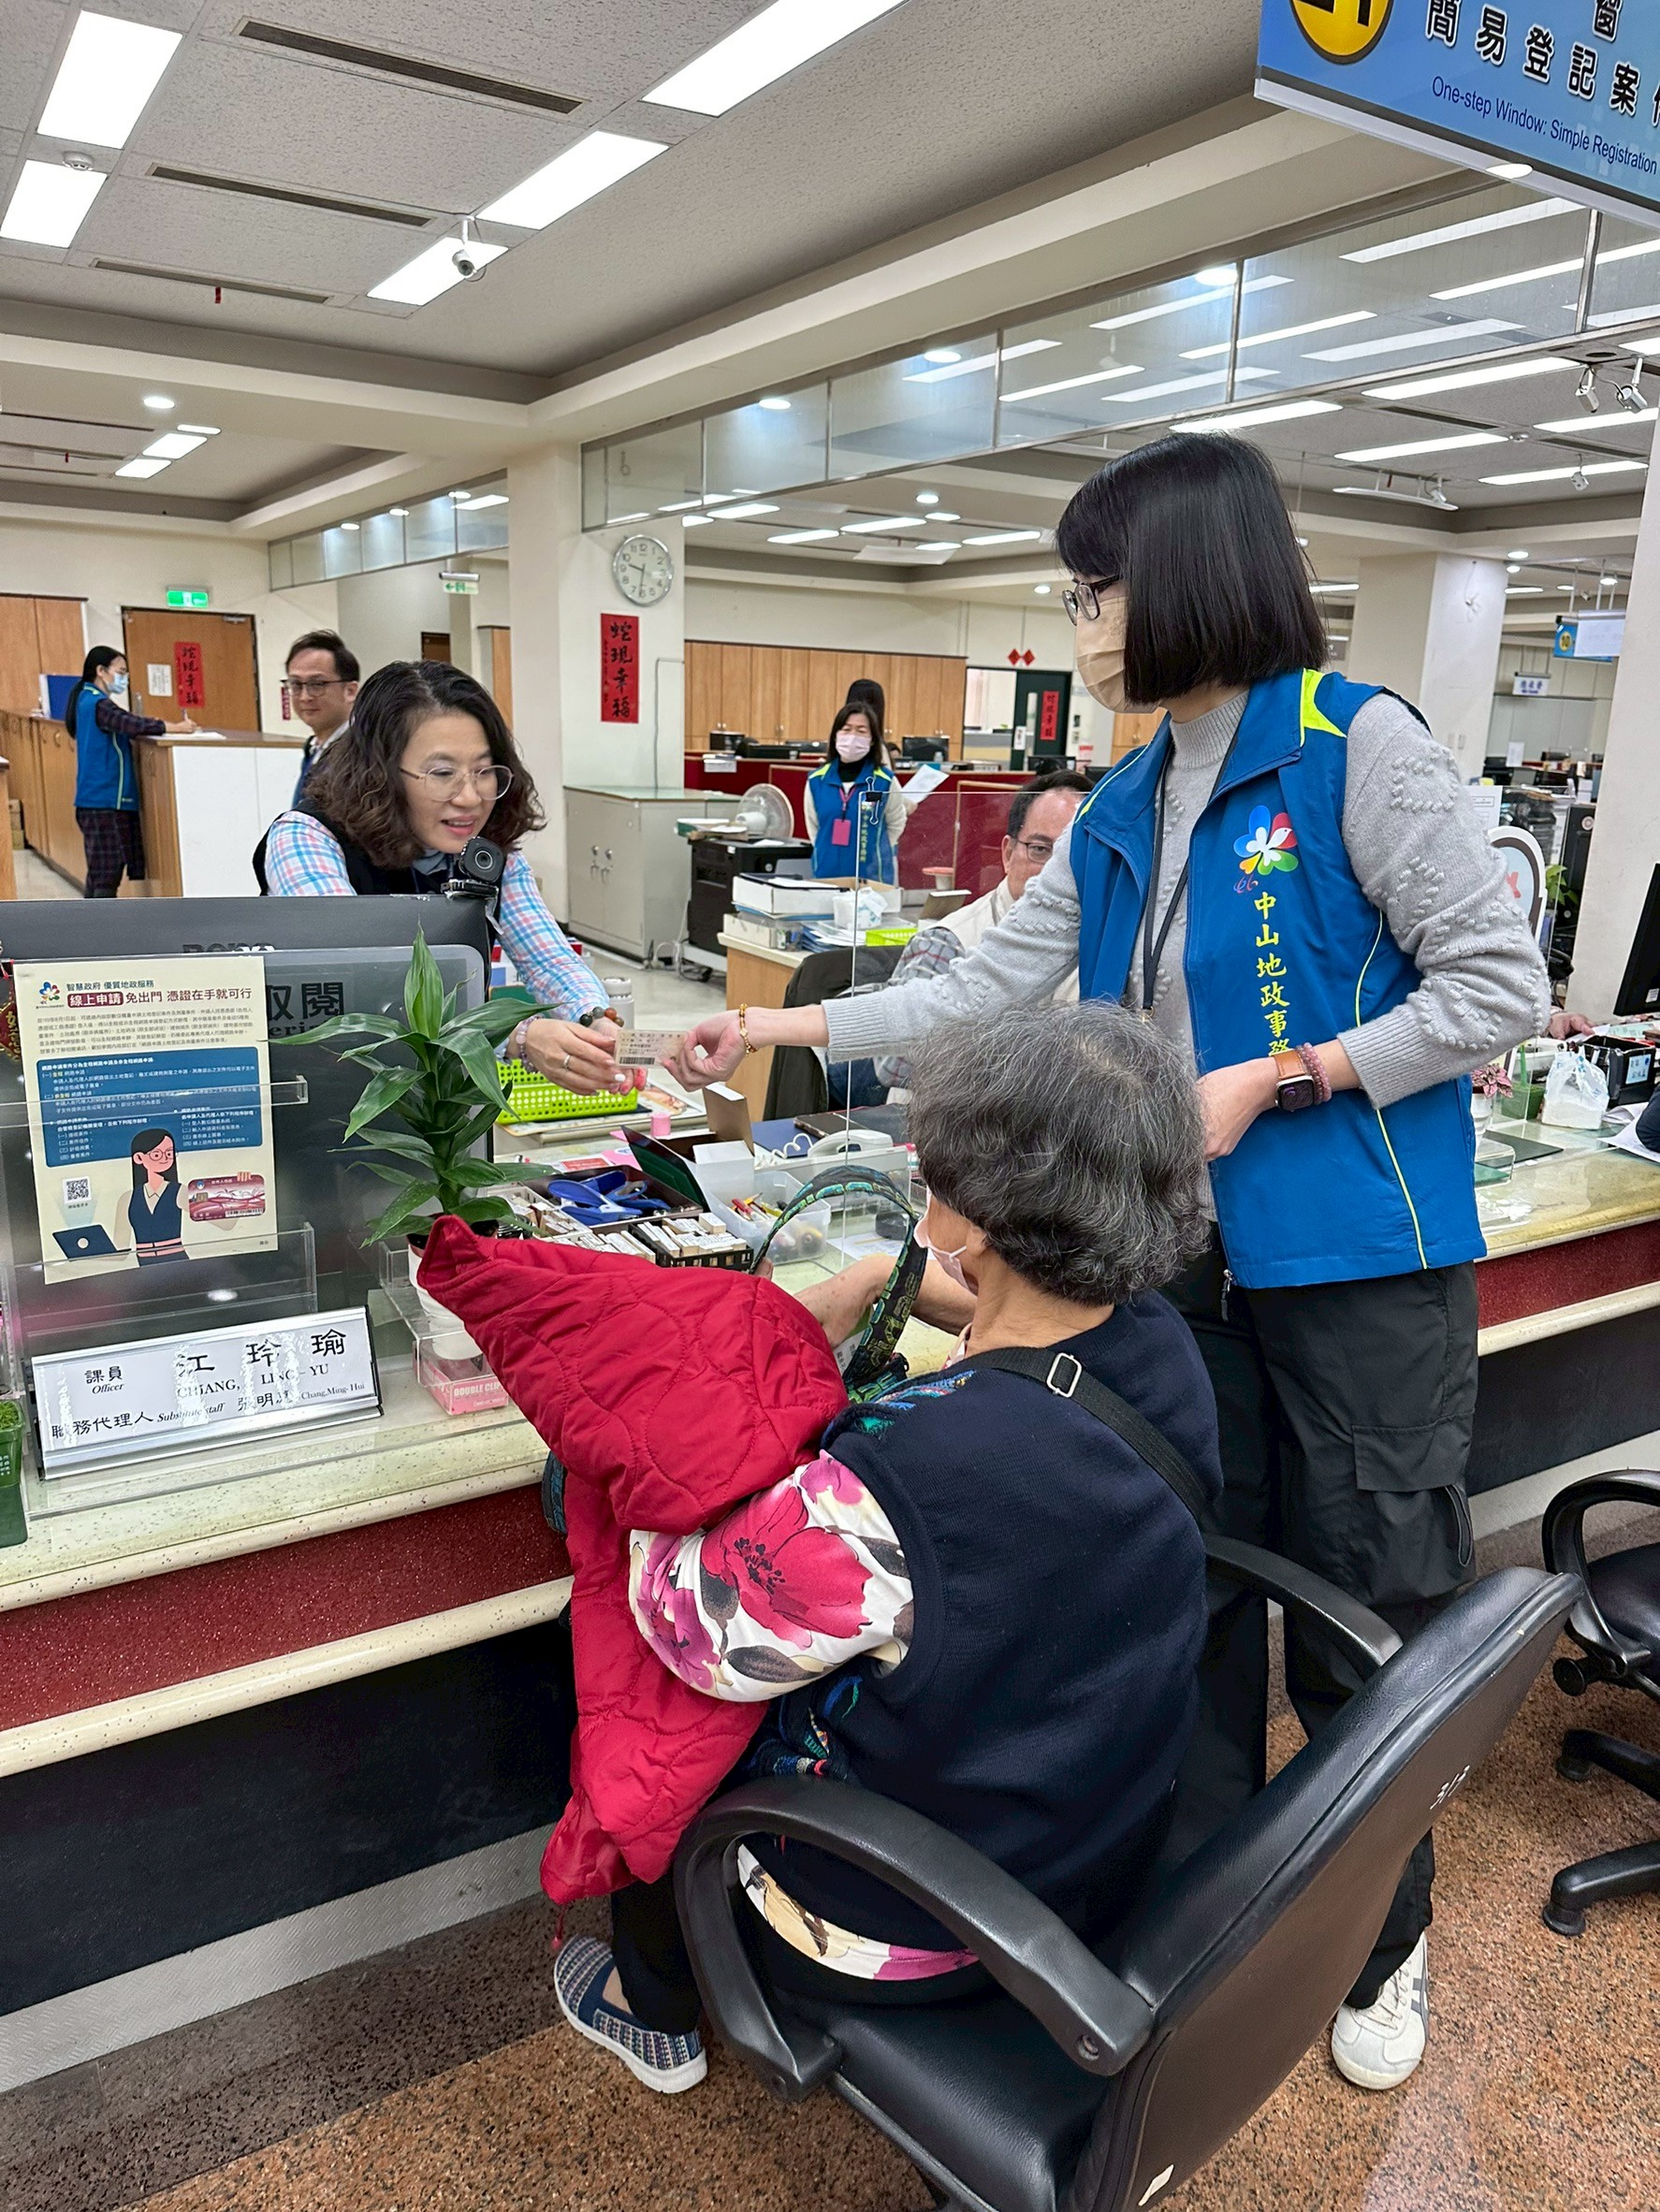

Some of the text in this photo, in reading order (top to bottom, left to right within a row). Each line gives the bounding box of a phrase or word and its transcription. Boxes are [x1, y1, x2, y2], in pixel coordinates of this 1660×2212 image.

[1433, 76, 1657, 175] One-step Window: Simple Registration
[66, 980, 154, 991] 智慧政府 優質地政服務
[69, 987, 252, 1007] 線上申請 免出門 憑證在手就可行
[84, 1365, 123, 1384] 課員
[92, 1383, 124, 1394] Officer
[454, 1385, 484, 1397] DOUBLE
